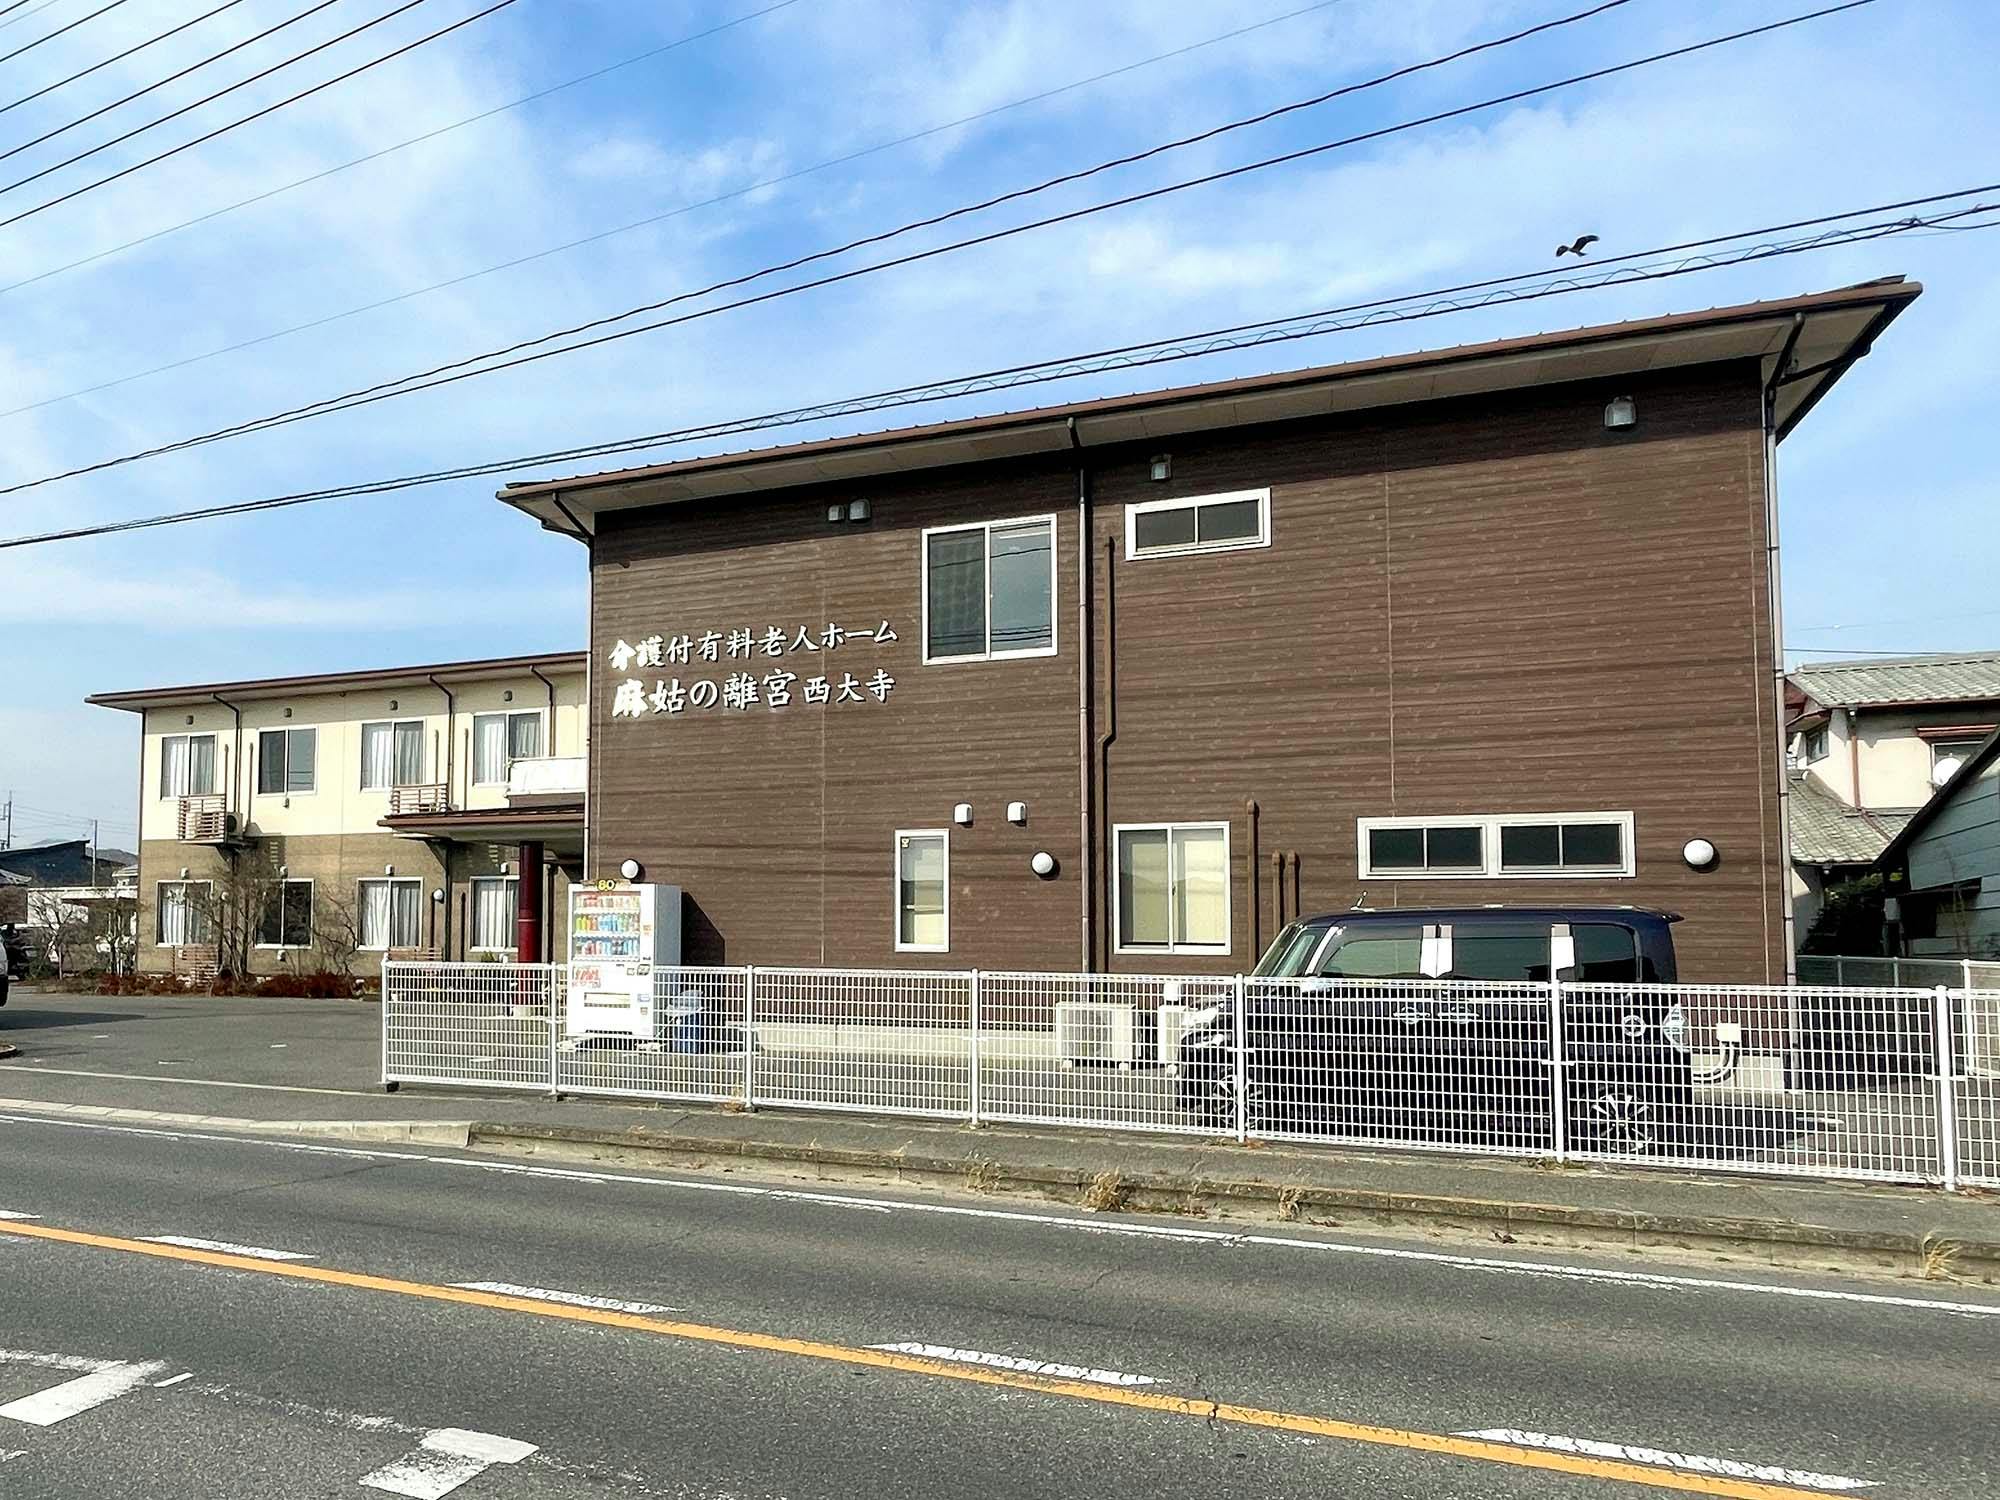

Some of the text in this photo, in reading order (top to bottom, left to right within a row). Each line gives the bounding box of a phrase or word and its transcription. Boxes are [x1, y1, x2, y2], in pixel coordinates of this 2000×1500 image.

[608, 620, 898, 671] 介護付有料老人ホーム
